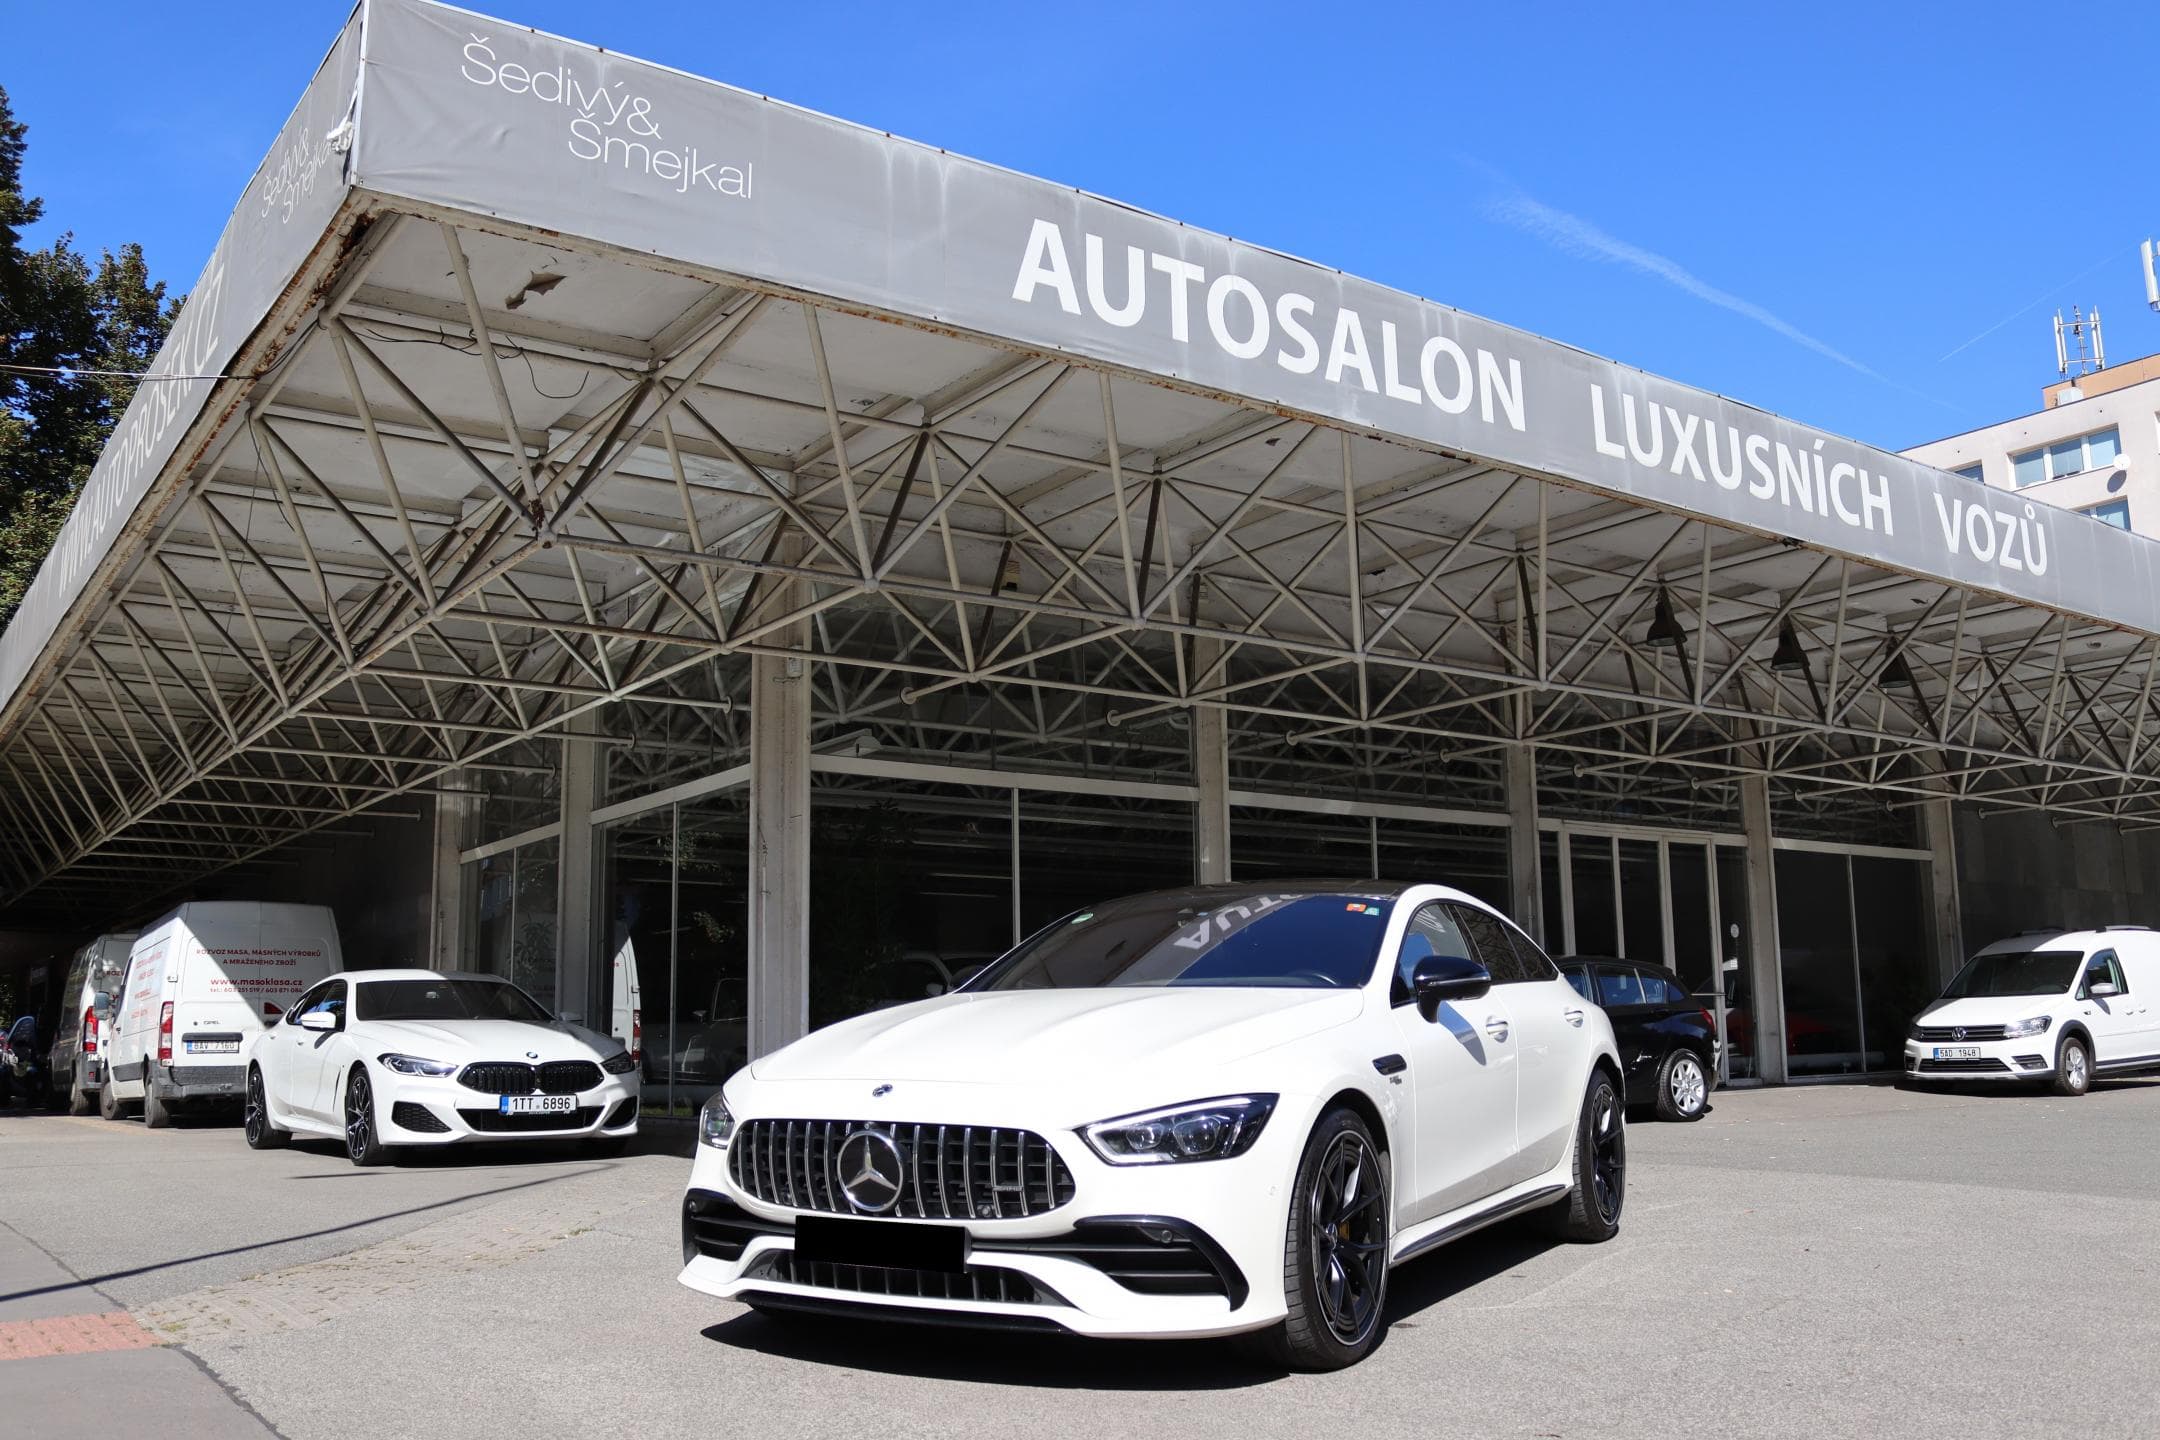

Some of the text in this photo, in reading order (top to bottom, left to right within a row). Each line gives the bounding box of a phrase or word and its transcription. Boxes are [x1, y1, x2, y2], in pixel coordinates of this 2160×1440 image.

[568, 108, 752, 199] Šmejkal
[1011, 218, 2049, 577] AUTOSALON LUXUSNÍCH VOZŮ
[210, 978, 303, 986] www.masoklasa.cz
[512, 1098, 571, 1110] 1TT 6896
